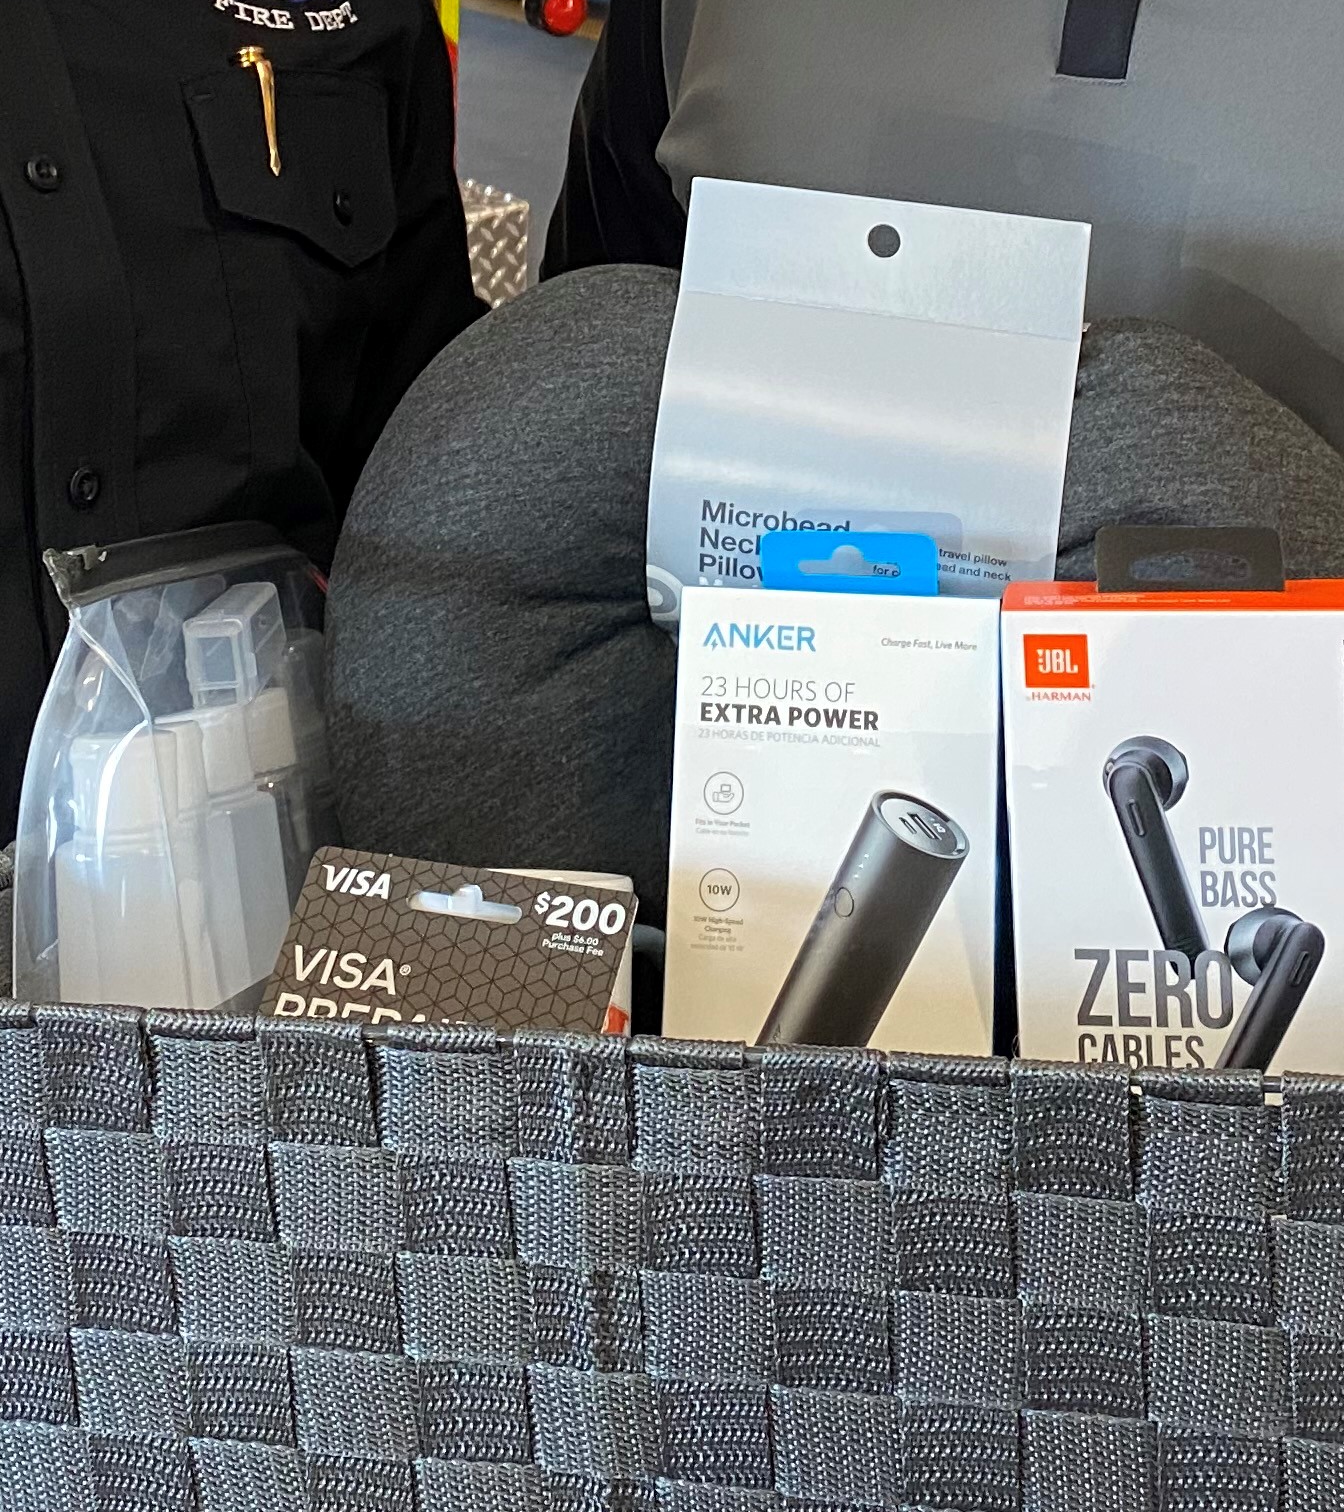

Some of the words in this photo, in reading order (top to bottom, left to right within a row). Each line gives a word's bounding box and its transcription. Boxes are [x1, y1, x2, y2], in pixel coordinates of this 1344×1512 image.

[304, 0, 359, 32] DEPT
[700, 526, 761, 556] Nec
[938, 548, 971, 562] travel
[973, 554, 1008, 568] pillow
[959, 567, 981, 577] and
[983, 570, 1012, 582] neck
[702, 623, 817, 653] ANKER
[880, 637, 911, 649] Charge
[935, 640, 953, 650] Live
[954, 641, 978, 651] More
[1036, 648, 1079, 674] JBL
[701, 675, 727, 698] 23
[735, 676, 817, 702] HOURS
[824, 681, 856, 704] OF
[1031, 691, 1092, 702] HARMAN
[700, 702, 782, 726] EXTRA
[788, 706, 879, 731] POWER
[698, 728, 711, 739] 23
[712, 729, 750, 741] HORAS
[750, 731, 766, 742] DE
[766, 731, 820, 745] POTENCIA
[820, 734, 881, 748] ADICIONAL
[1199, 826, 1276, 865] PURE
[322, 864, 392, 900] VISA
[706, 884, 733, 896] 10W
[1200, 870, 1278, 908] BASS
[534, 891, 626, 935] $200
[542, 938, 585, 954] Purchase
[586, 945, 604, 957] Fee
[551, 932, 572, 943] plus
[573, 934, 599, 946] $6.00
[1074, 948, 1234, 1029] ZERO
[1078, 1033, 1205, 1069] CABLES
